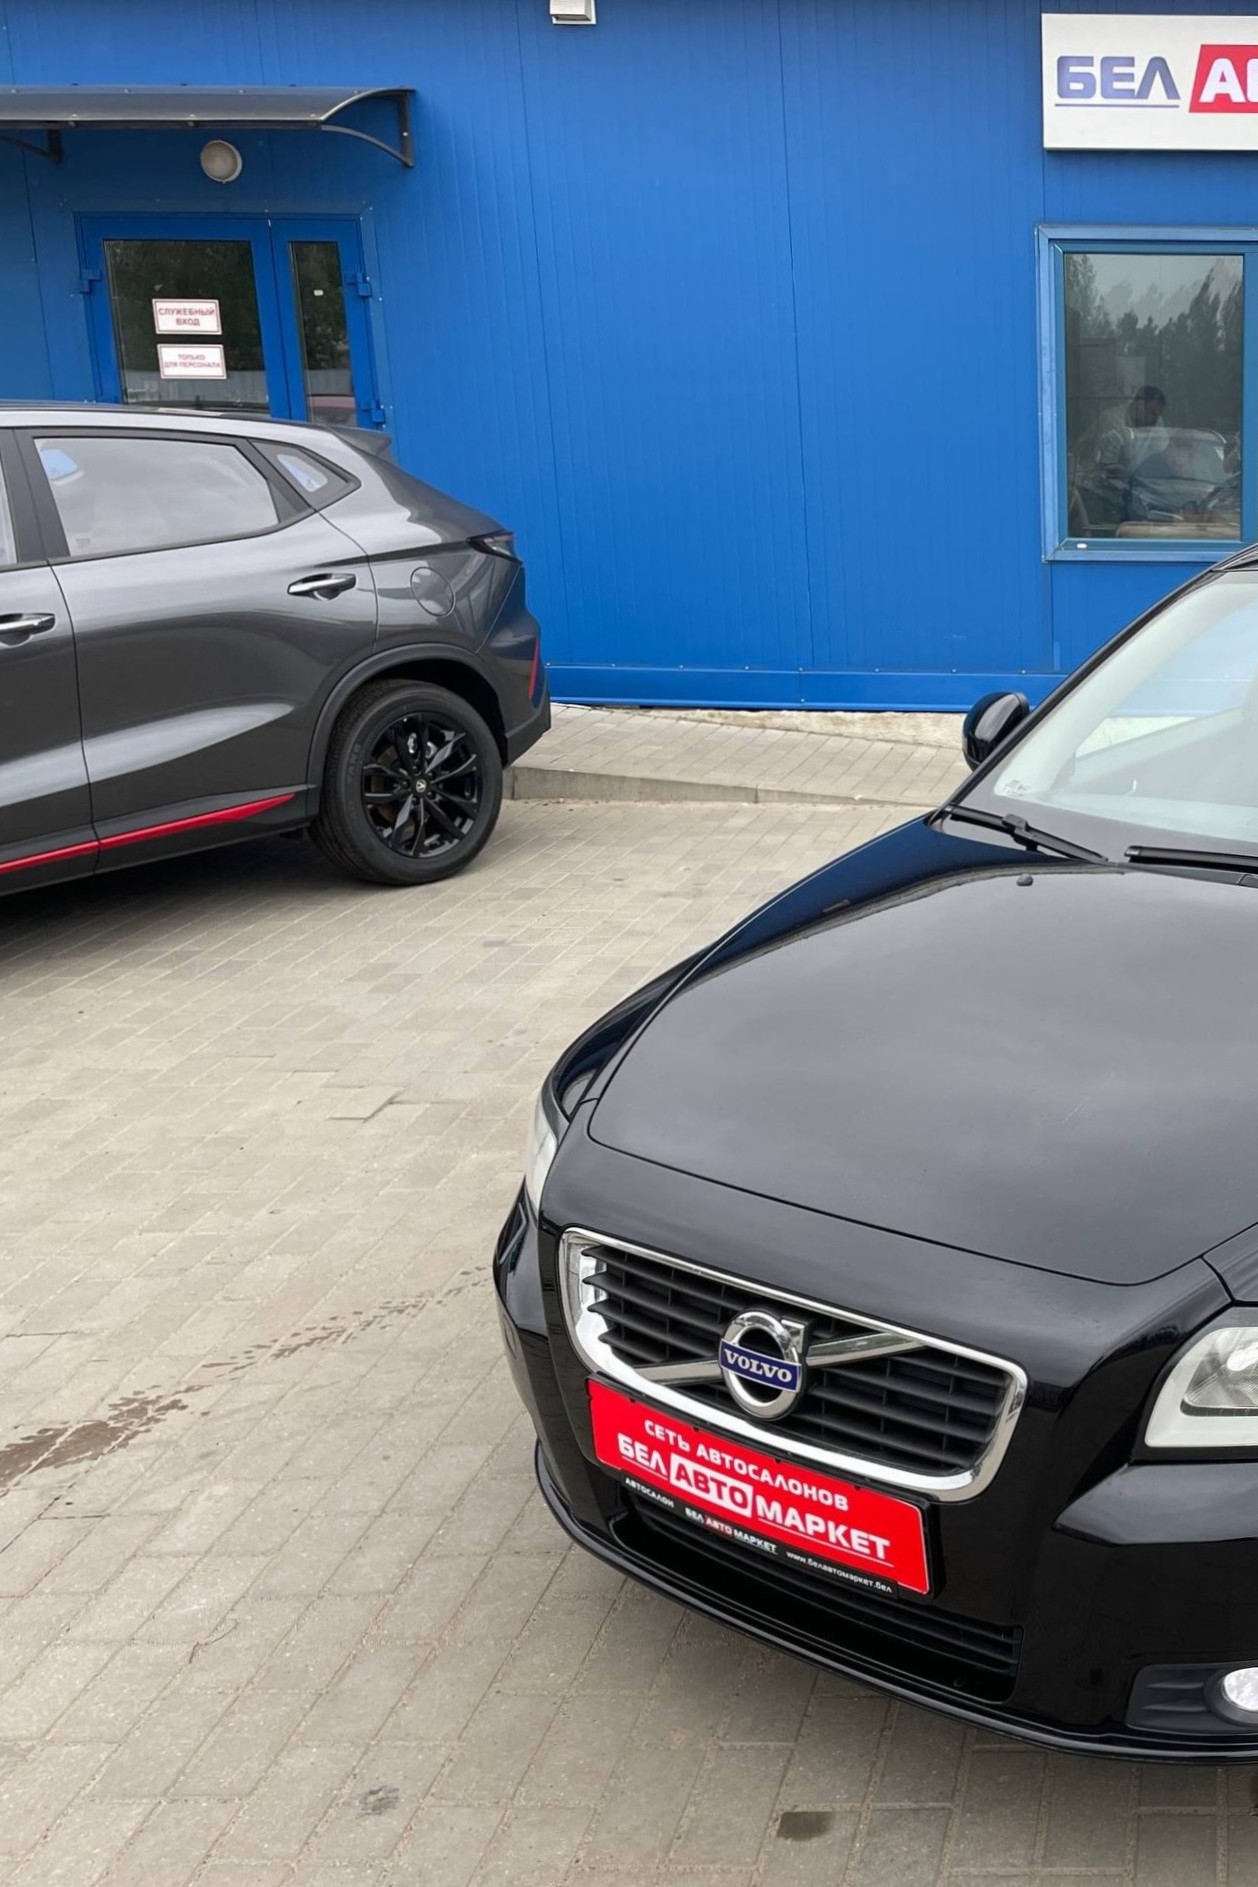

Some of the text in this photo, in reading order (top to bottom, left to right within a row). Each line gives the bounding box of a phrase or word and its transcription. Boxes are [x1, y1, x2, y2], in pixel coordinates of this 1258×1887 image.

[1056, 55, 1181, 101] БЕЛ
[158, 307, 215, 316] СЛУЖЕБНЫЙ
[176, 318, 200, 326] ВХОД
[724, 1348, 793, 1384] VOLVO
[644, 1419, 849, 1511] СЕТЬ АВТОСАЛОНОВ
[617, 1432, 891, 1560] БЕЛ АВТО МАРКЕТ
[625, 1477, 893, 1594] АВТОСАЛОН БЕЛ АВТО МАРКЕТ www.белавтомаркет.бел
